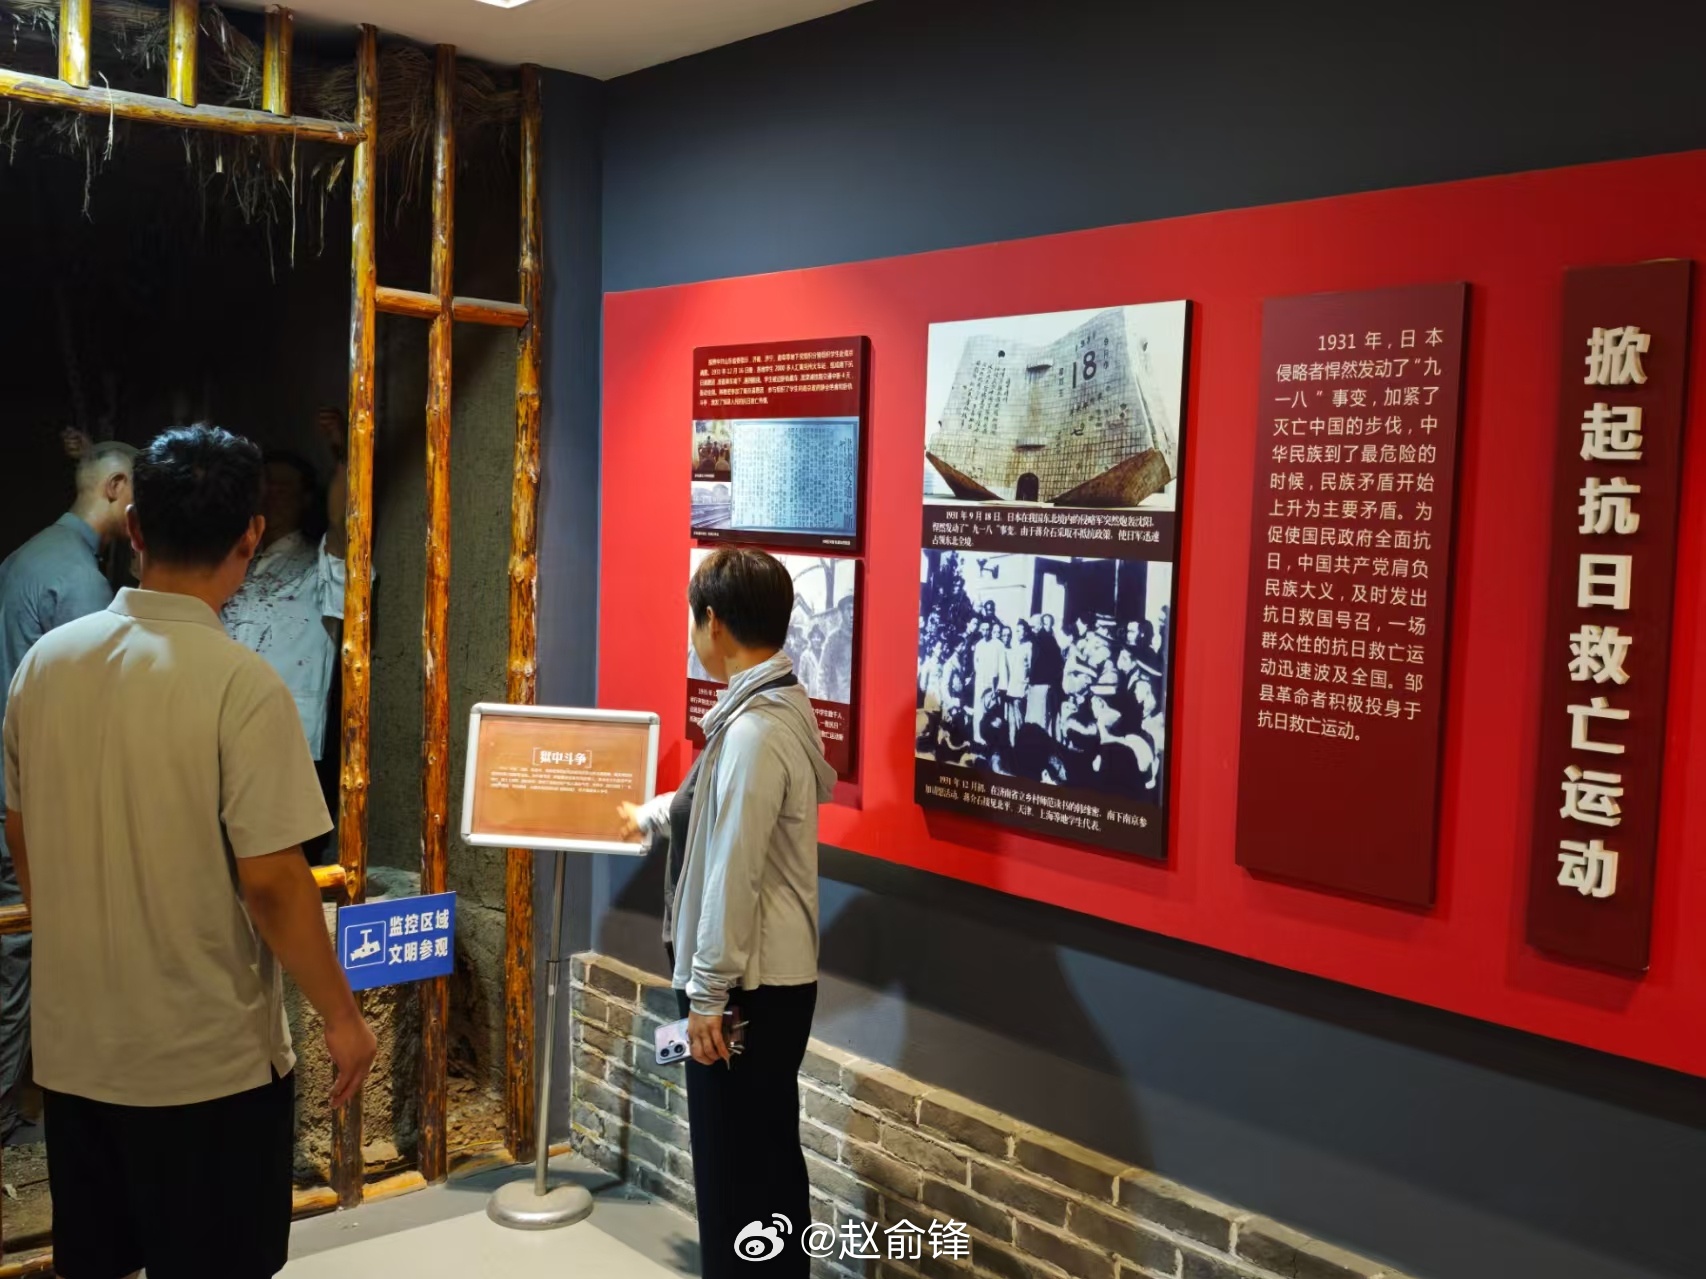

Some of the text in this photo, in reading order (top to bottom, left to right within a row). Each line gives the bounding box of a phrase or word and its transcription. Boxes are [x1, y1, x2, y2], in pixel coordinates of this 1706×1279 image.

[1072, 350, 1097, 389] 18
[1273, 414, 1438, 437] 灭亡中国的步伐，中
[1271, 444, 1437, 465] 华民族到了最危险的
[1269, 472, 1435, 493] 时候，民族矛盾开始
[1268, 499, 1433, 521] 上升为主要矛盾。为
[1267, 525, 1432, 551] 促使国民政府全面抗
[1266, 552, 1429, 579] 日，中国共产党肩负
[1265, 578, 1427, 608] 民族大义，及时发出
[1263, 604, 1426, 636] 抗日救国号召，一场
[1557, 325, 1650, 898] 掀起抗日救亡运动
[1261, 631, 1425, 664] 群众性的抗日救亡运
[1260, 657, 1423, 693] 动迅速波及全国。邹
[1258, 683, 1422, 721] 县革命者积极投身于
[1257, 709, 1361, 741] 抗日救亡运动。
[388, 908, 450, 937] 监控区域
[388, 936, 449, 966] 文明参观
